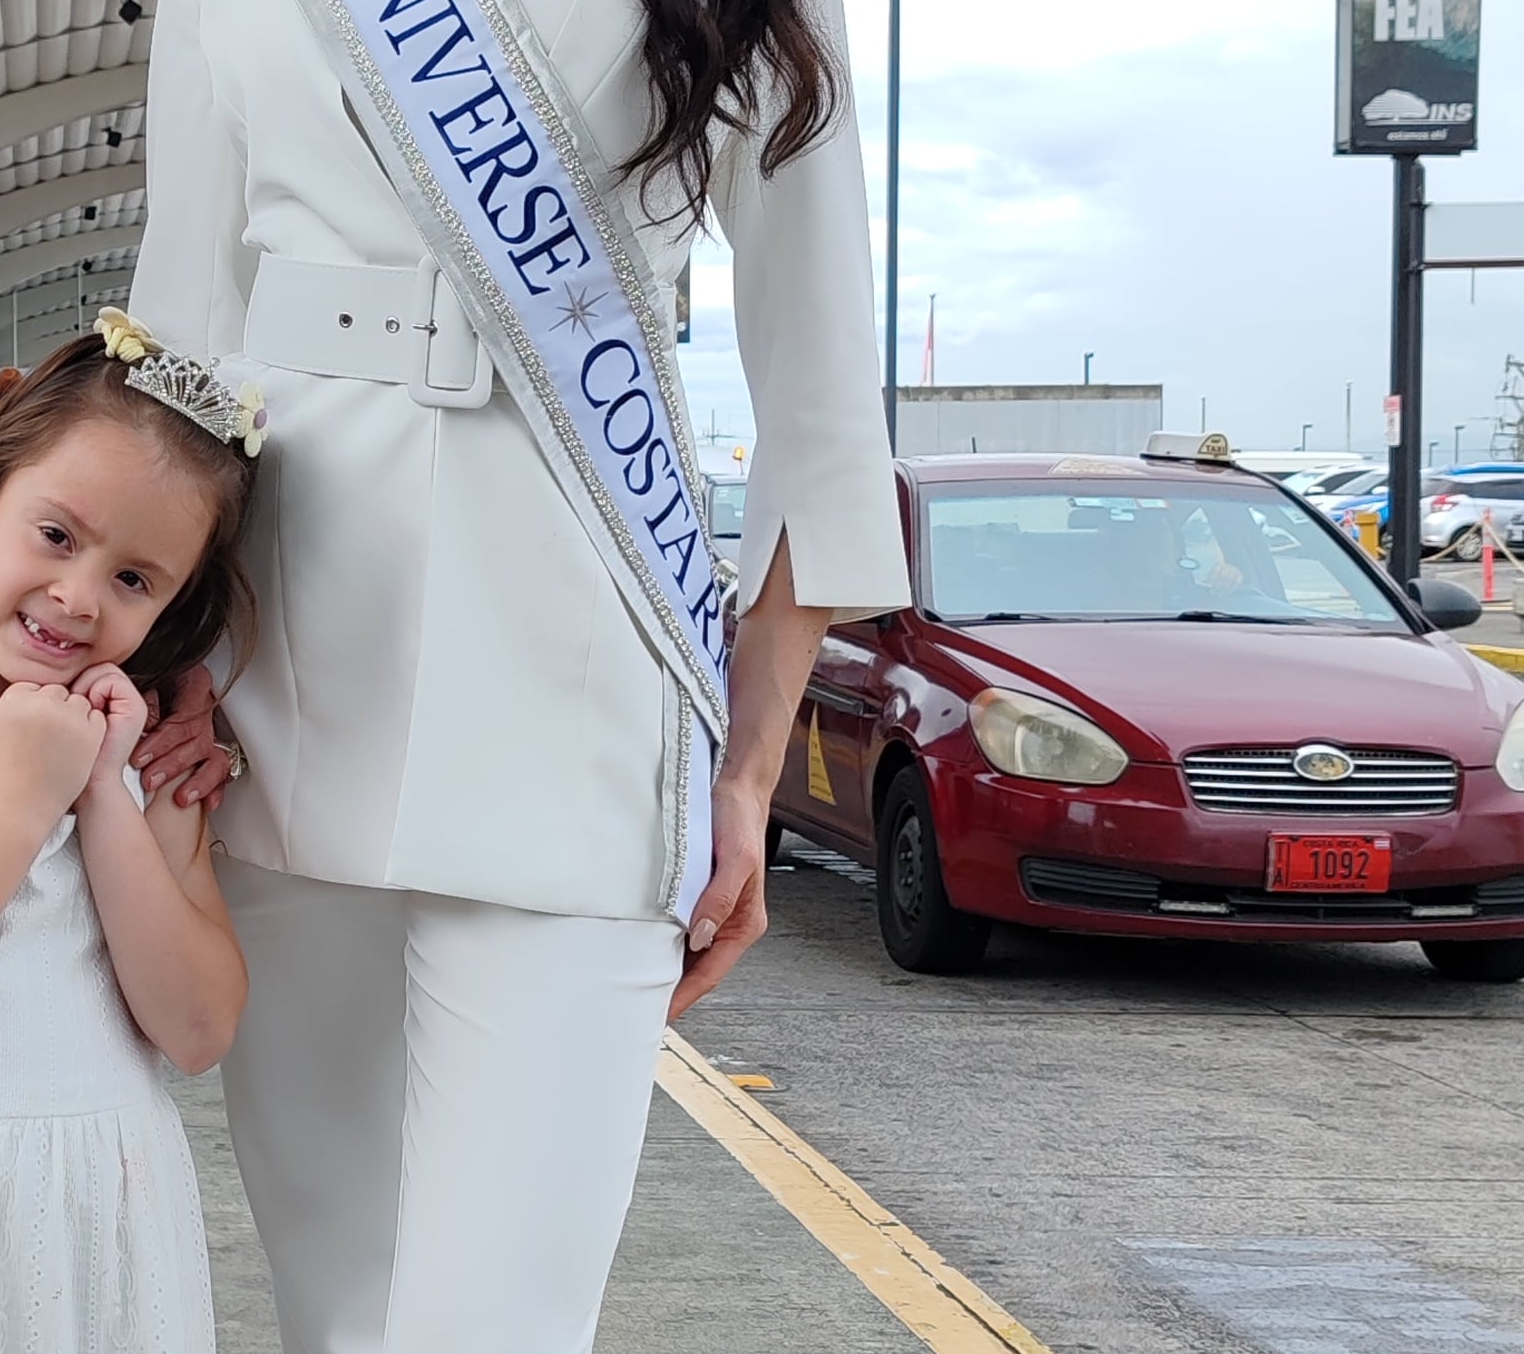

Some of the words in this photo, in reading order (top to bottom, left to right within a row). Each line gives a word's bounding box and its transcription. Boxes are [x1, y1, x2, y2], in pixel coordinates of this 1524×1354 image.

[1429, 102, 1474, 122] INS
[1205, 444, 1225, 453] TAXI
[580, 339, 699, 596] COSTA
[1309, 848, 1371, 880] 1092
